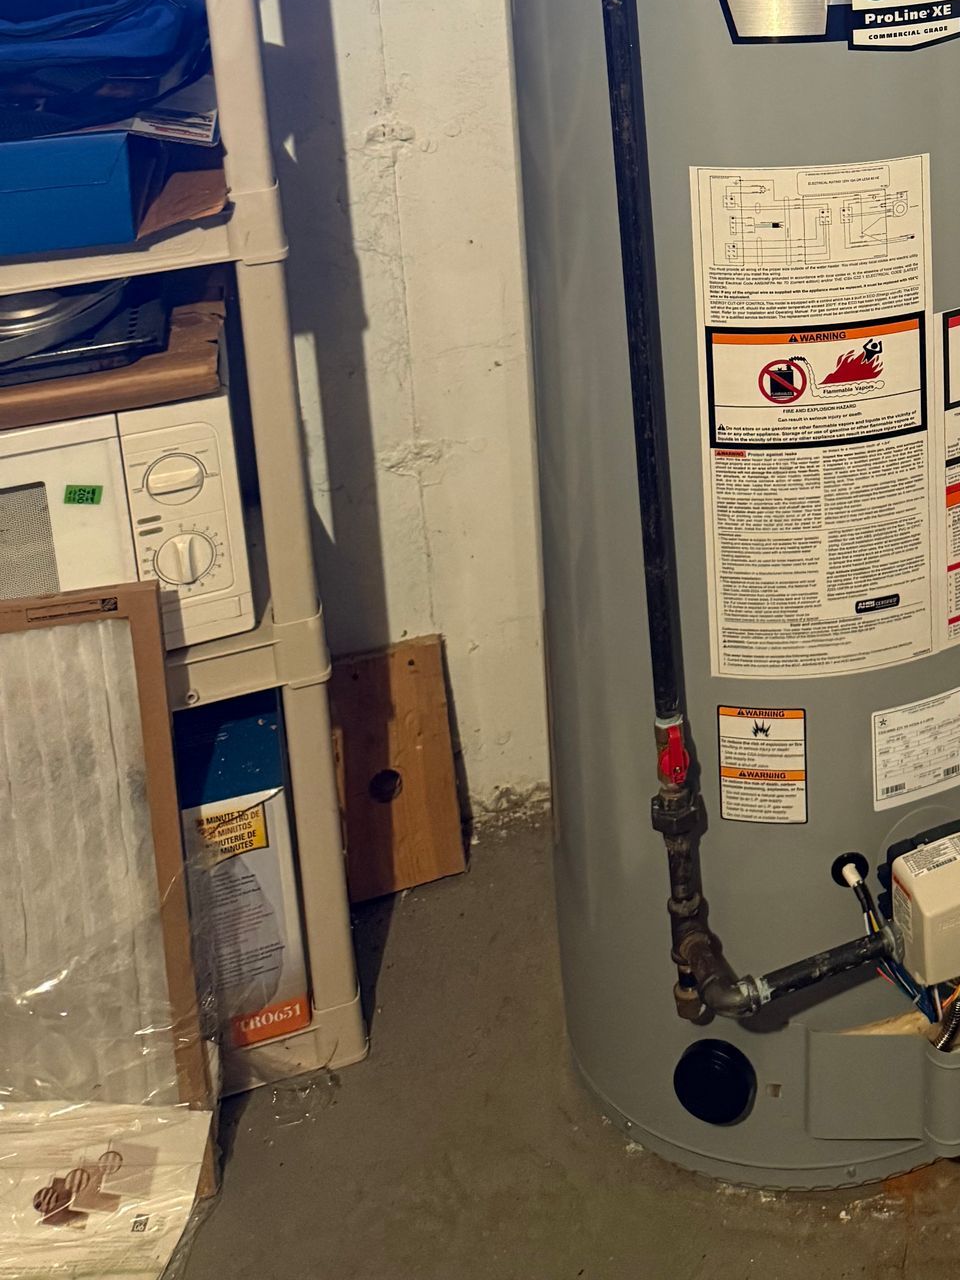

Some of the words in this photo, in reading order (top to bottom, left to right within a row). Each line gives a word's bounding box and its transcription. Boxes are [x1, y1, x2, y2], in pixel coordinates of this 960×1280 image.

[932, 4, 951, 17] XE
[869, 30, 920, 40] COMMERCIAL
[800, 331, 846, 342] WARNING
[206, 812, 234, 824] MINUTE
[250, 810, 260, 818] DE
[217, 822, 252, 837] MINUTOS
[220, 840, 254, 853] MINUTES
